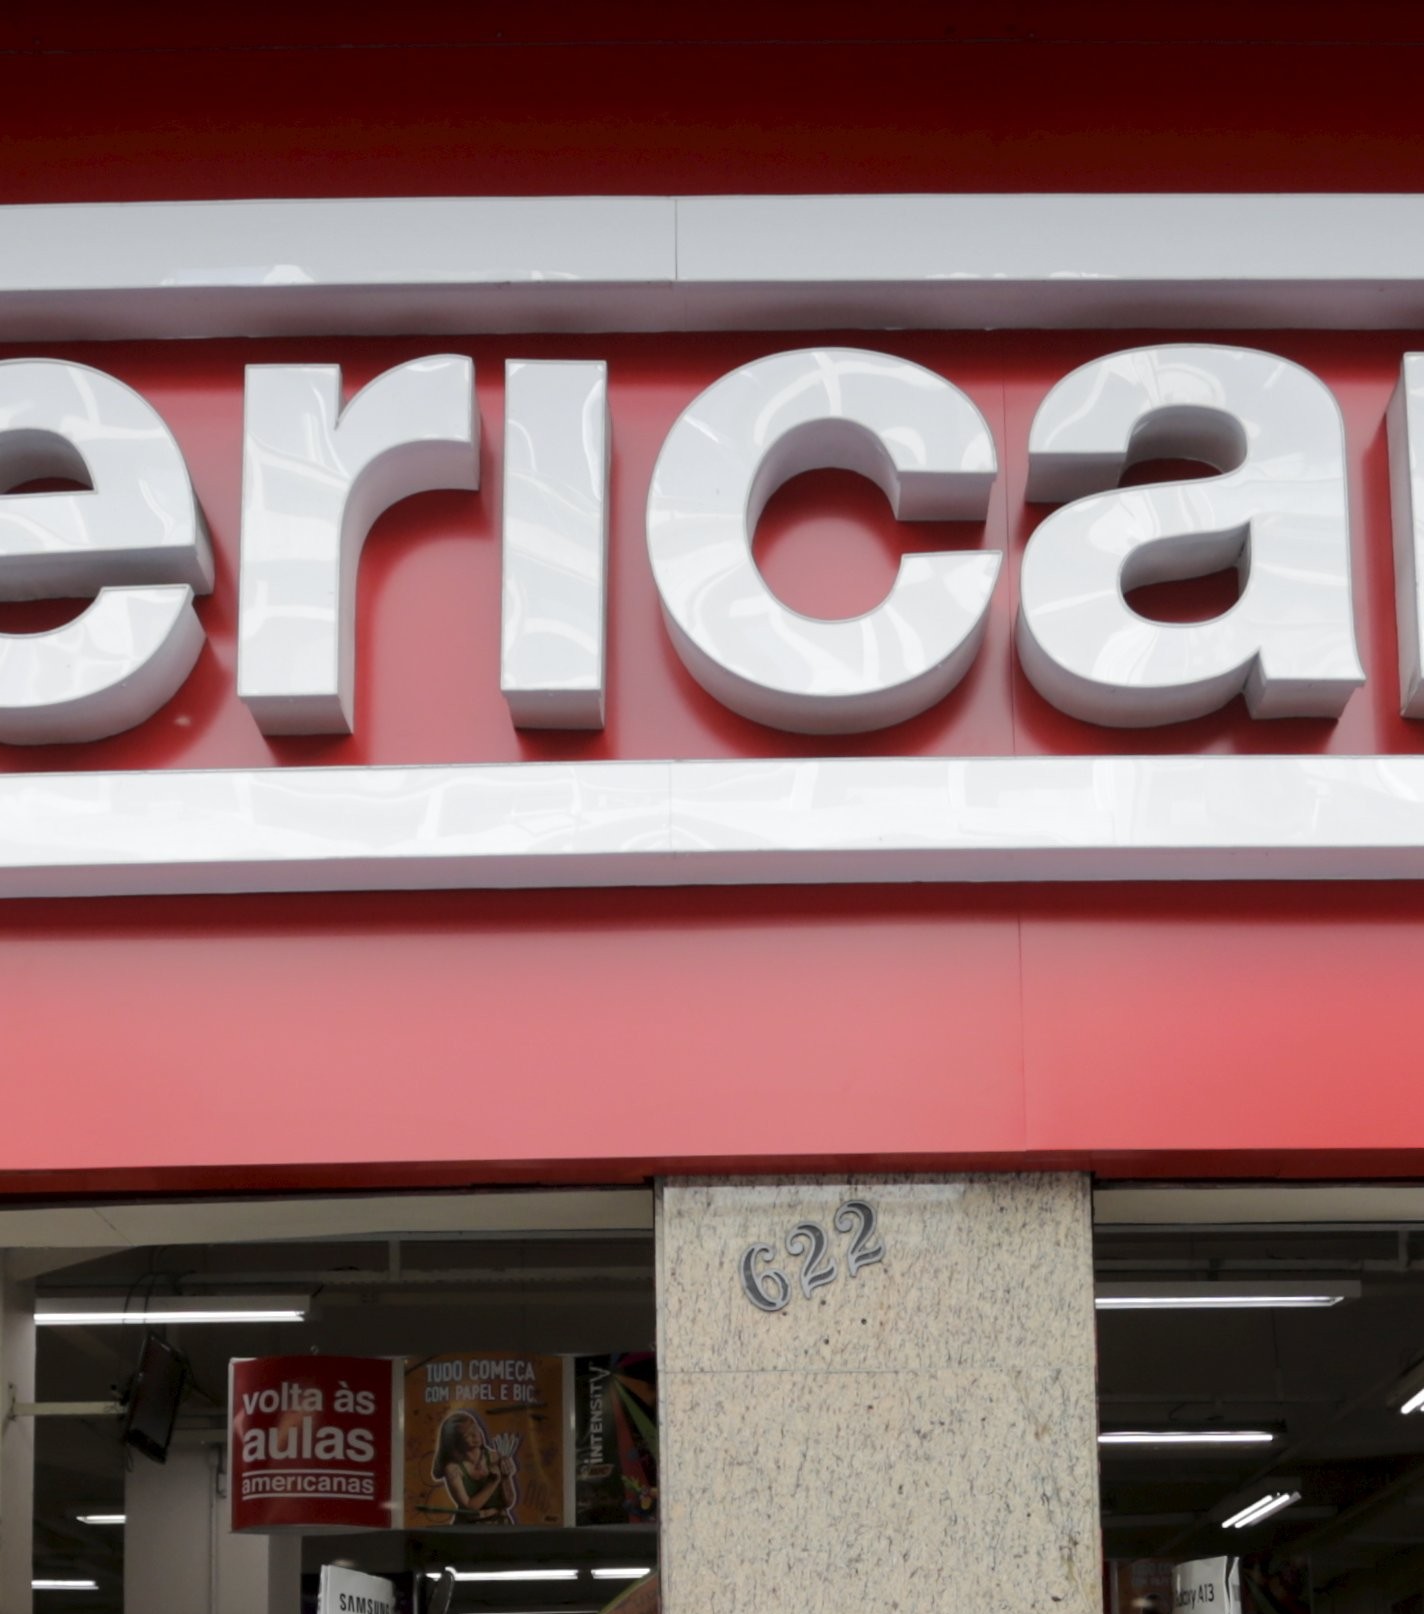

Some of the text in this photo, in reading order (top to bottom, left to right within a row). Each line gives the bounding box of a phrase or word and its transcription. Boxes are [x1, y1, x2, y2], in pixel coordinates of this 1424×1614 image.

[740, 1200, 885, 1312] 622
[426, 1360, 536, 1383] TUDO COMEÇA
[242, 1381, 375, 1415] volta às
[425, 1385, 450, 1403] COM
[456, 1383, 496, 1402] PAPEL
[500, 1384, 509, 1401] E
[241, 1415, 375, 1463] aulas
[241, 1472, 375, 1496] americanas
[1198, 1584, 1215, 1602] A13
